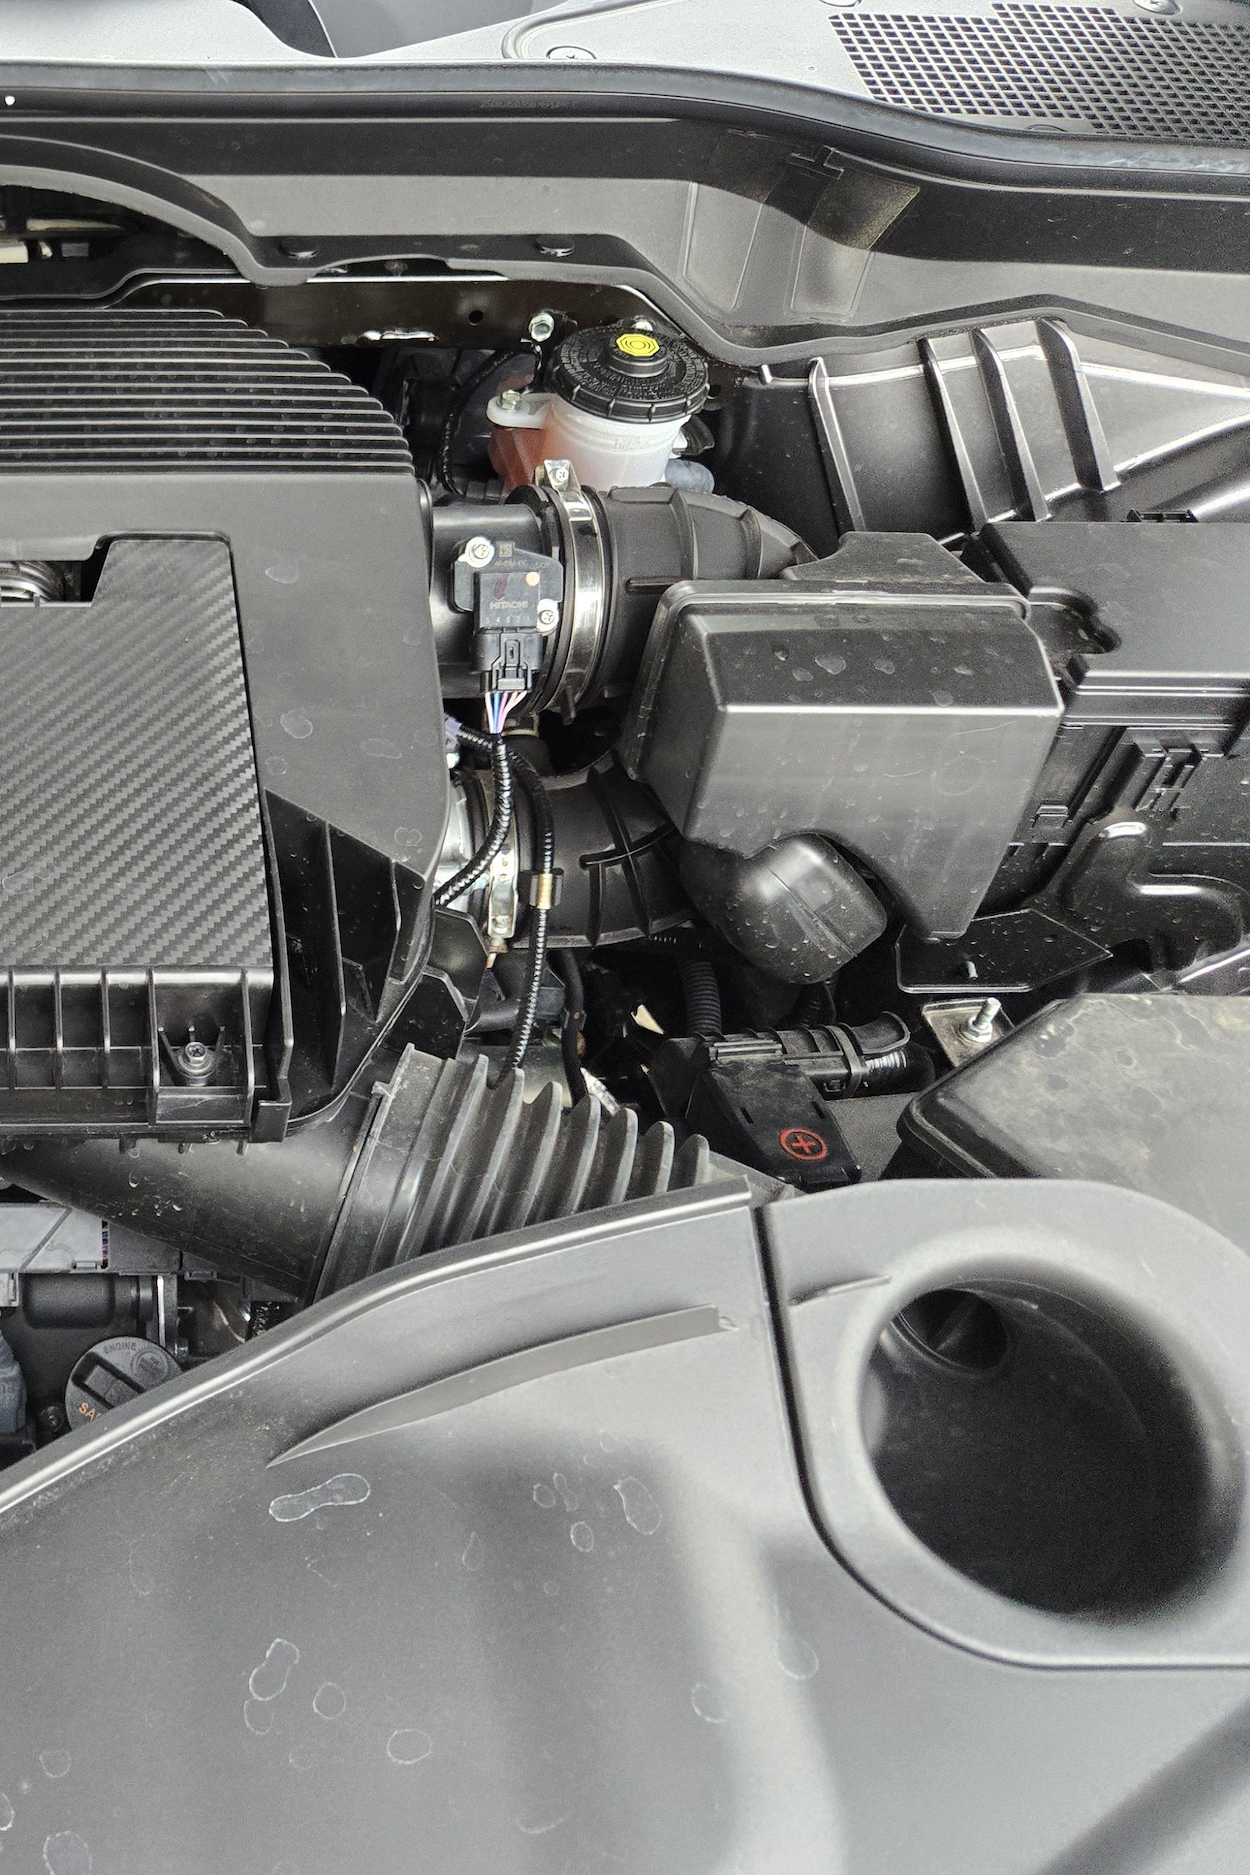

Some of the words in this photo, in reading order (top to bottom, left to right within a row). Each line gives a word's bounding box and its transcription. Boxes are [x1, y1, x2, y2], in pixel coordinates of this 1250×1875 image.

[490, 600, 529, 610] HITACHI
[103, 1341, 137, 1354] ENGINE
[79, 1402, 101, 1420] SA
